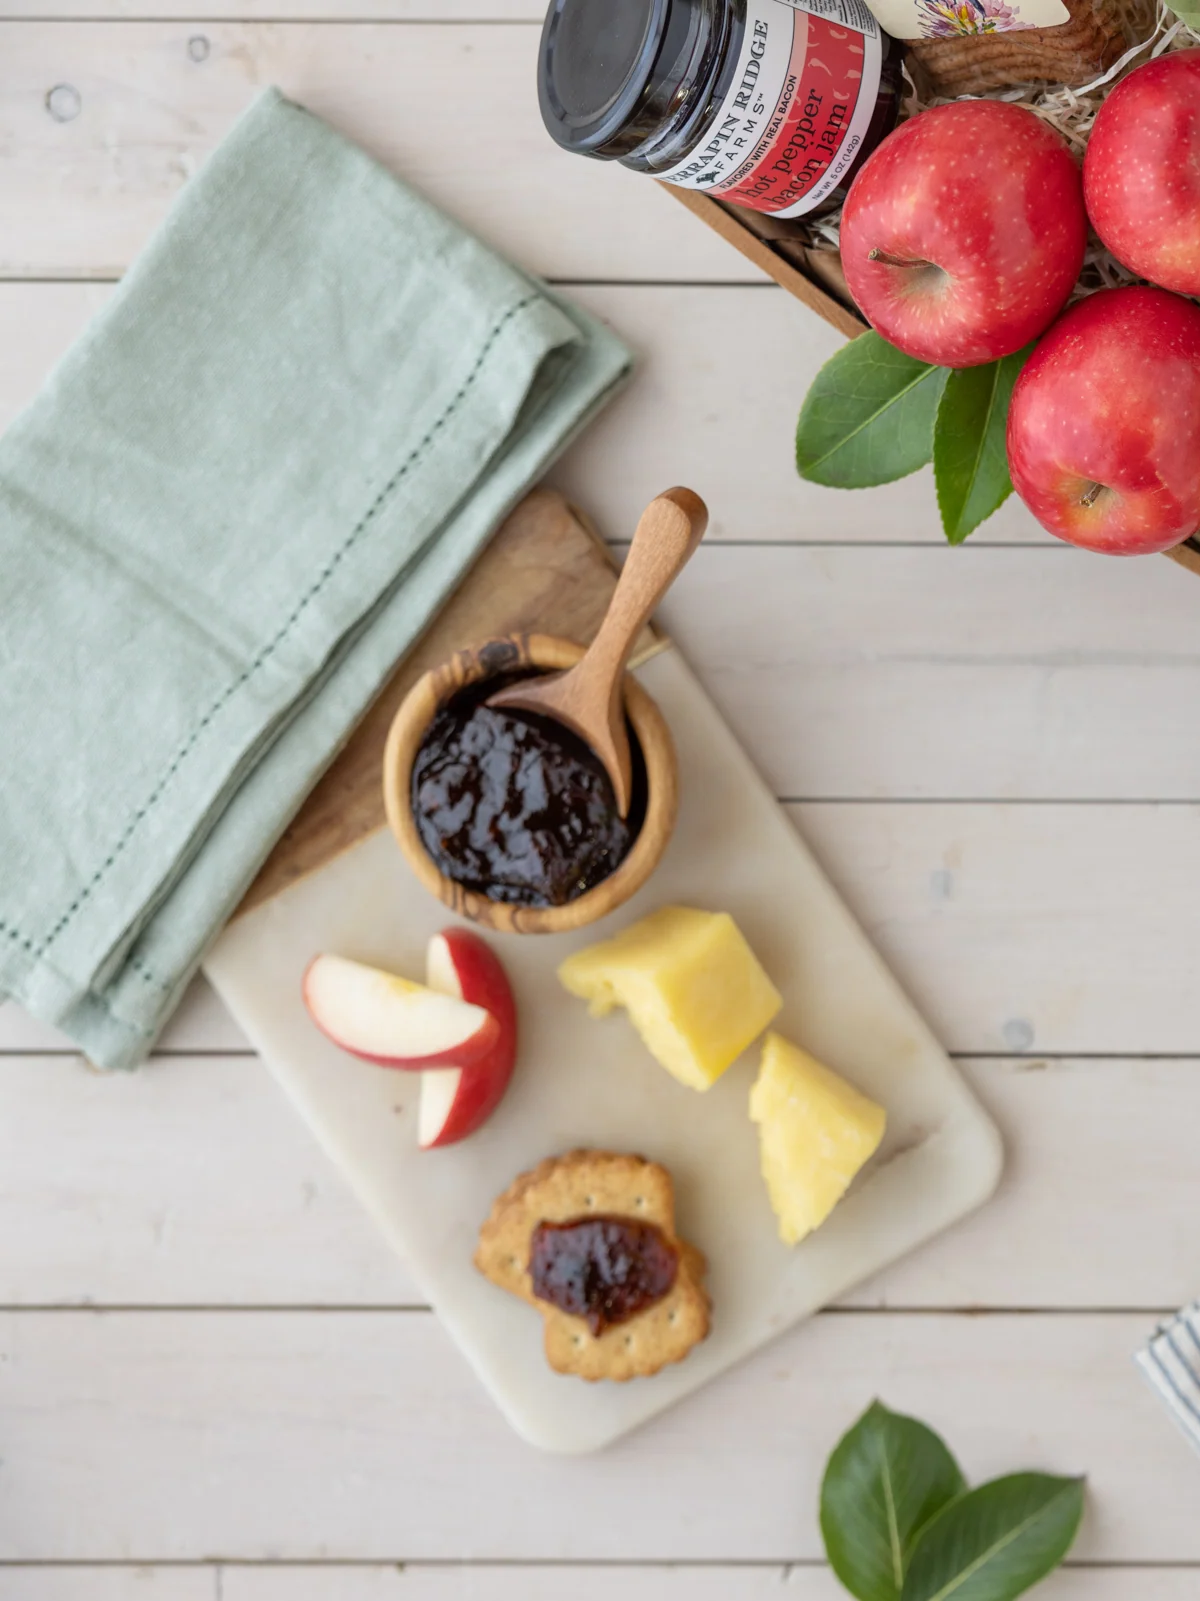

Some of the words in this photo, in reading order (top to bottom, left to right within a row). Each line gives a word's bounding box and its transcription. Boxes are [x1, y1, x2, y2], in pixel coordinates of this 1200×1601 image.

[665, 113, 741, 183] ERRAPIN
[732, 19, 768, 112] RIDGE
[720, 161, 754, 189] FLAVORED
[752, 141, 770, 165] WITH
[767, 116, 783, 143] REAL
[779, 75, 797, 116] BACON
[735, 173, 777, 200] hot
[772, 88, 823, 175] pepper
[763, 156, 823, 206] bacon
[810, 102, 848, 156] jam
[842, 135, 861, 162] (142g)
